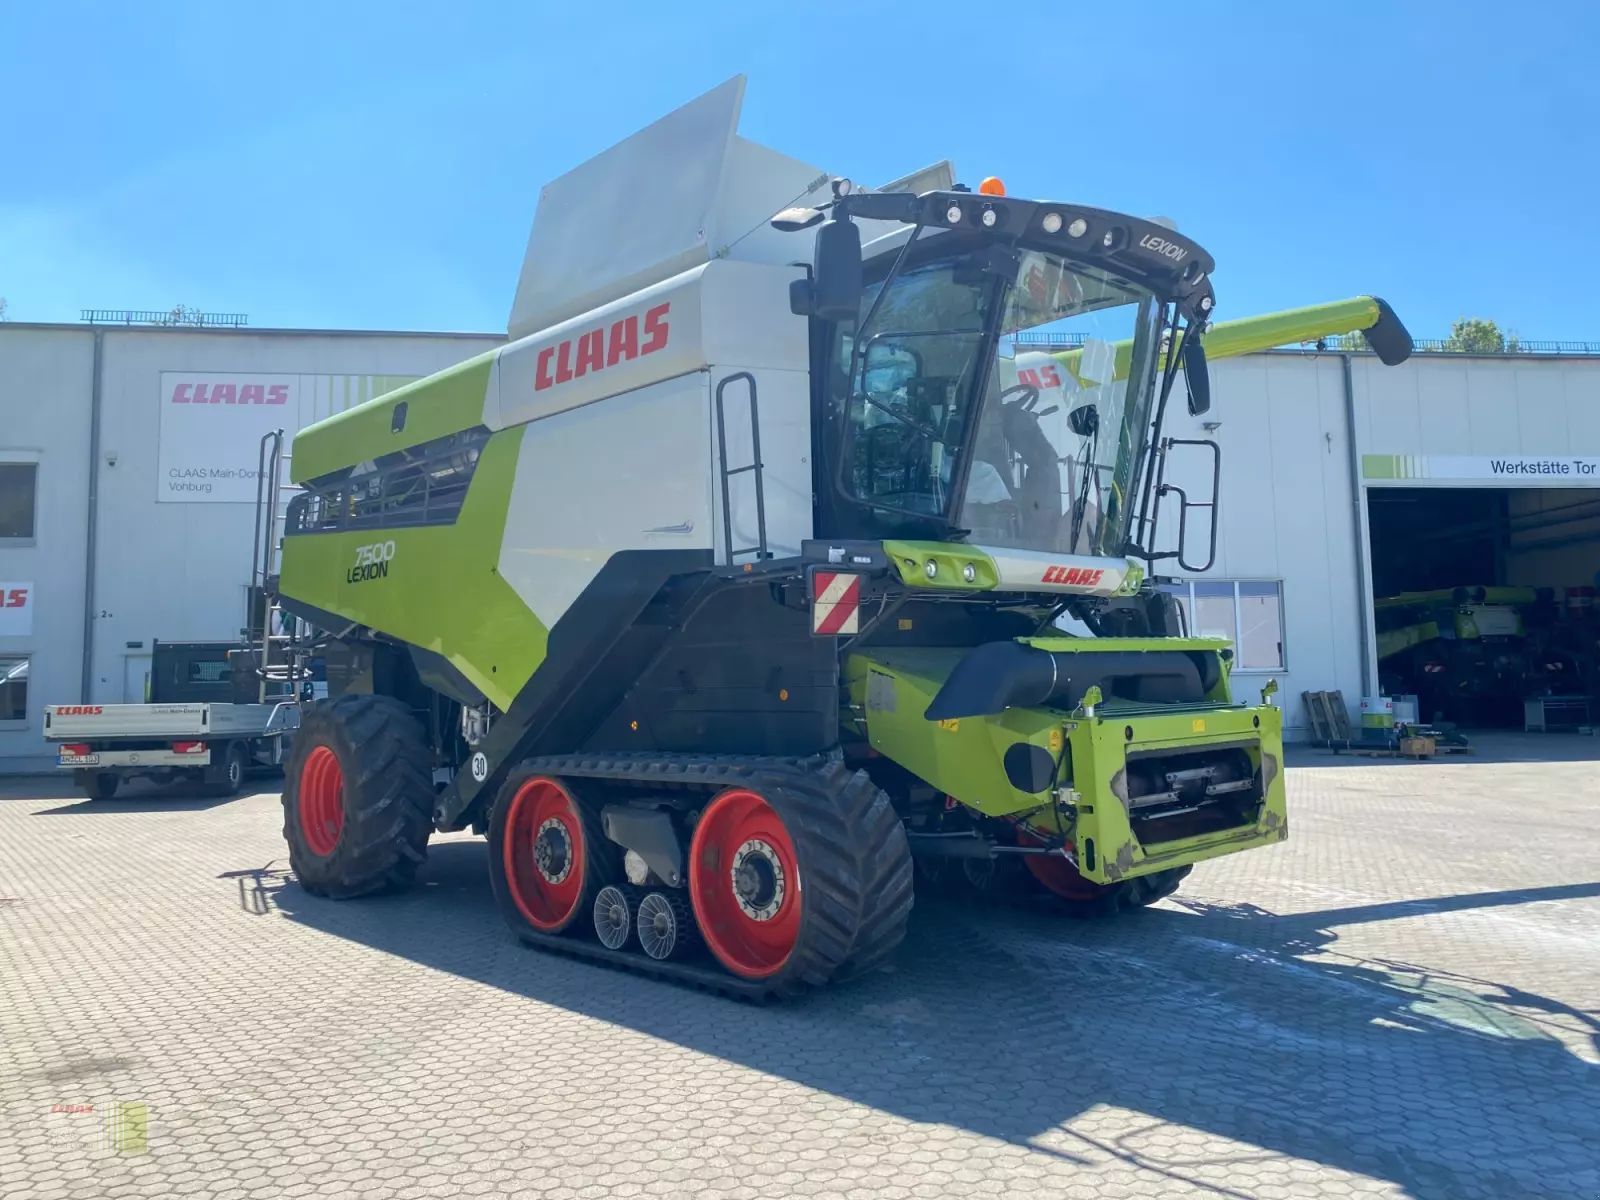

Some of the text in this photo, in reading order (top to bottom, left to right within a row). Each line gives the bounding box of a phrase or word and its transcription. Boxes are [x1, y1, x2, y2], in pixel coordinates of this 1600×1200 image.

[1139, 234, 1188, 262] LEXION
[534, 302, 671, 391] CLAAS
[171, 383, 290, 405] CLAAS
[168, 468, 208, 478] CLAAS
[1491, 460, 1597, 474] Werkstätte Tor
[356, 540, 396, 567] 7500
[347, 560, 389, 584] LEXION
[1041, 565, 1105, 586] CLAAS
[0, 589, 28, 608] S
[56, 706, 103, 715] CLAAS
[474, 757, 485, 776] 30
